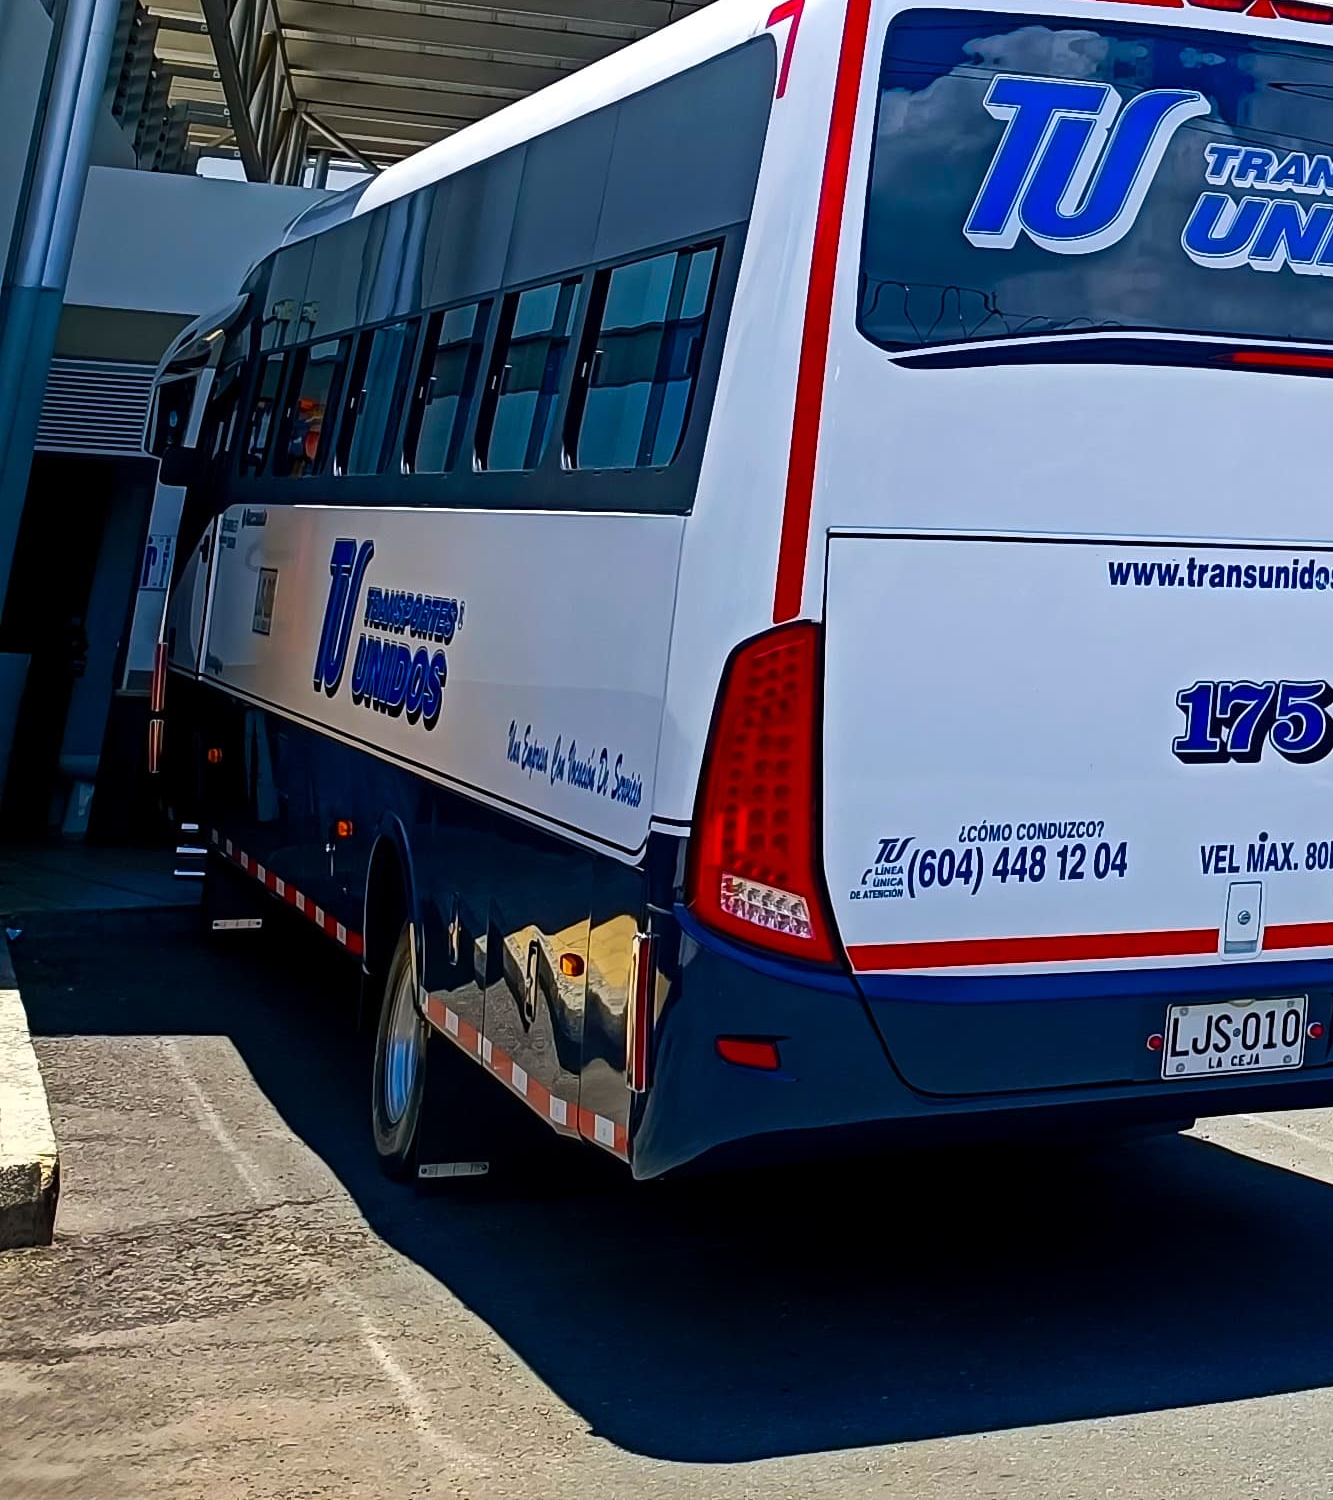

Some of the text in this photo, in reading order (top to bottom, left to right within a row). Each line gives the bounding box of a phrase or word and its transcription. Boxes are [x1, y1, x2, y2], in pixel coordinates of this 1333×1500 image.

[964, 74, 1210, 254] TU
[313, 537, 374, 699] TU
[364, 586, 458, 645] TRANSPORTES
[352, 633, 448, 731] UNIDOS
[875, 836, 916, 864] TU
[958, 820, 1105, 842] ¿CÓMO CONDUZCO?
[907, 842, 1127, 898] (604) 448 12 04
[1200, 844, 1240, 874] VEL
[850, 889, 860, 900] DE
[1208, 1054, 1260, 1069] LA CEJA
